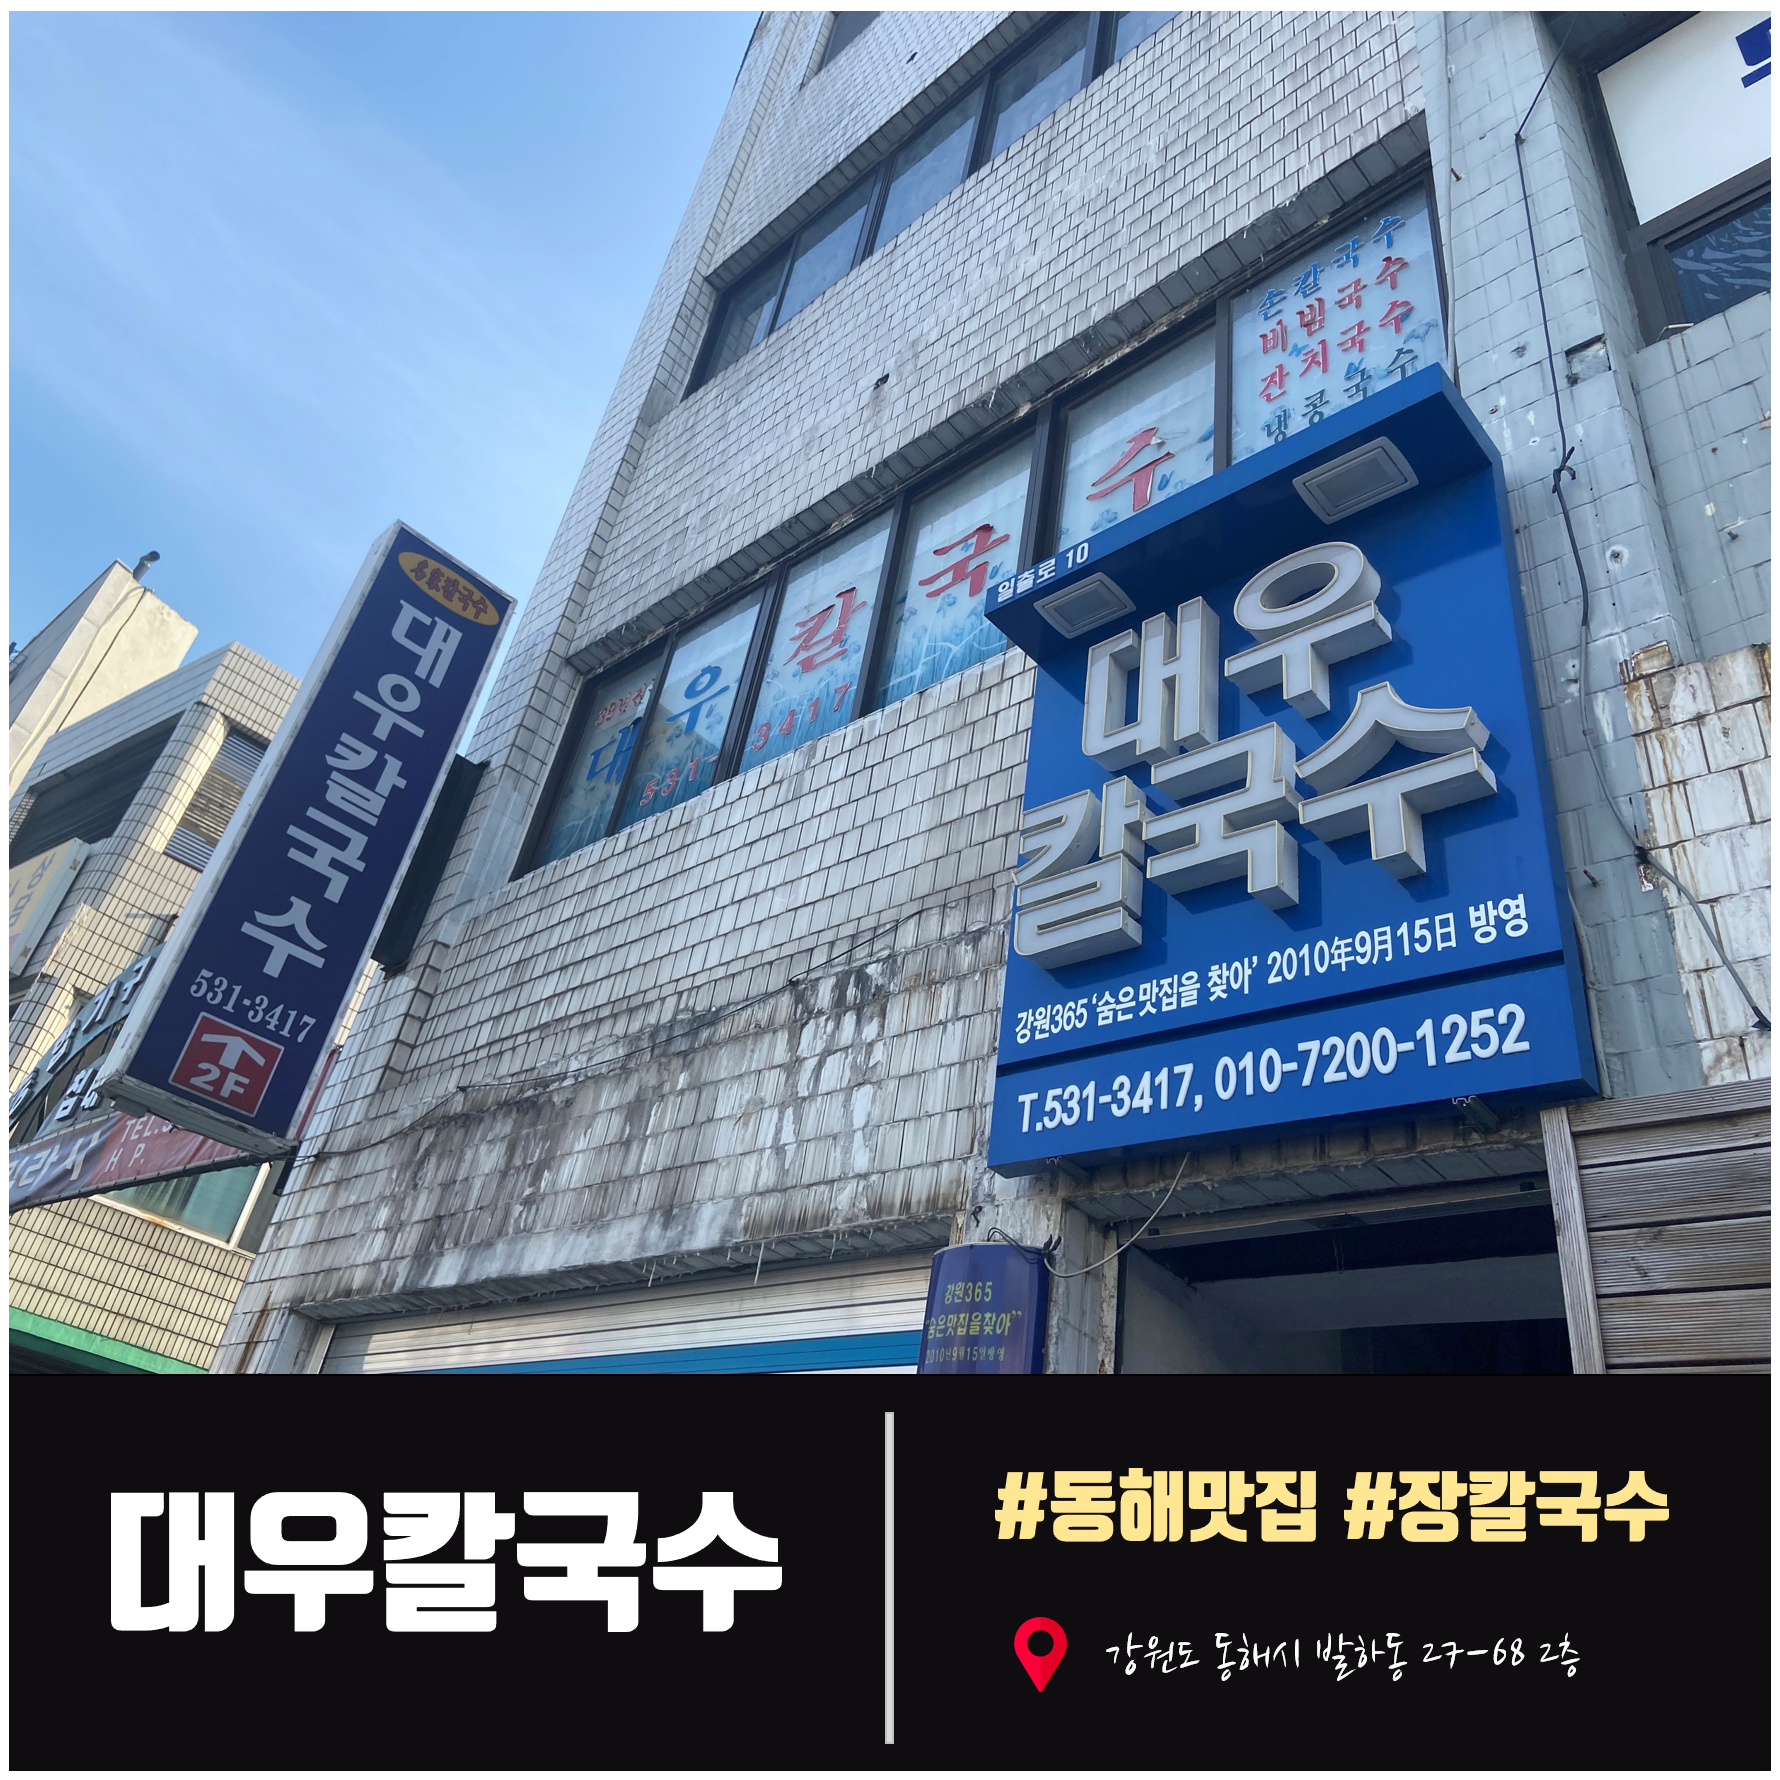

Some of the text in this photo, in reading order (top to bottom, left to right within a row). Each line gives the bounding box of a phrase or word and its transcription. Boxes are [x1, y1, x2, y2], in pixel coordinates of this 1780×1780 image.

[1257, 215, 1406, 321] 손칼국수
[1259, 256, 1409, 354] 비빔국수
[1259, 300, 1415, 403] 잔치국수
[1264, 347, 1418, 444] 냉콩국수
[997, 542, 1089, 603] 일출로 10
[1083, 541, 1392, 772] 대우
[240, 599, 463, 978] 대우칼국수
[1011, 681, 1497, 970] 칼국수
[189, 968, 317, 1044] 531-3417
[1015, 998, 1088, 1044] 강원365
[1266, 912, 1457, 984] 2010年9月15日
[1468, 893, 1529, 944] 방영
[189, 1062, 250, 1099] 2F
[1017, 1002, 1531, 1134] T.531-3417, 010-7200-1252
[944, 1281, 993, 1305] 강원365
